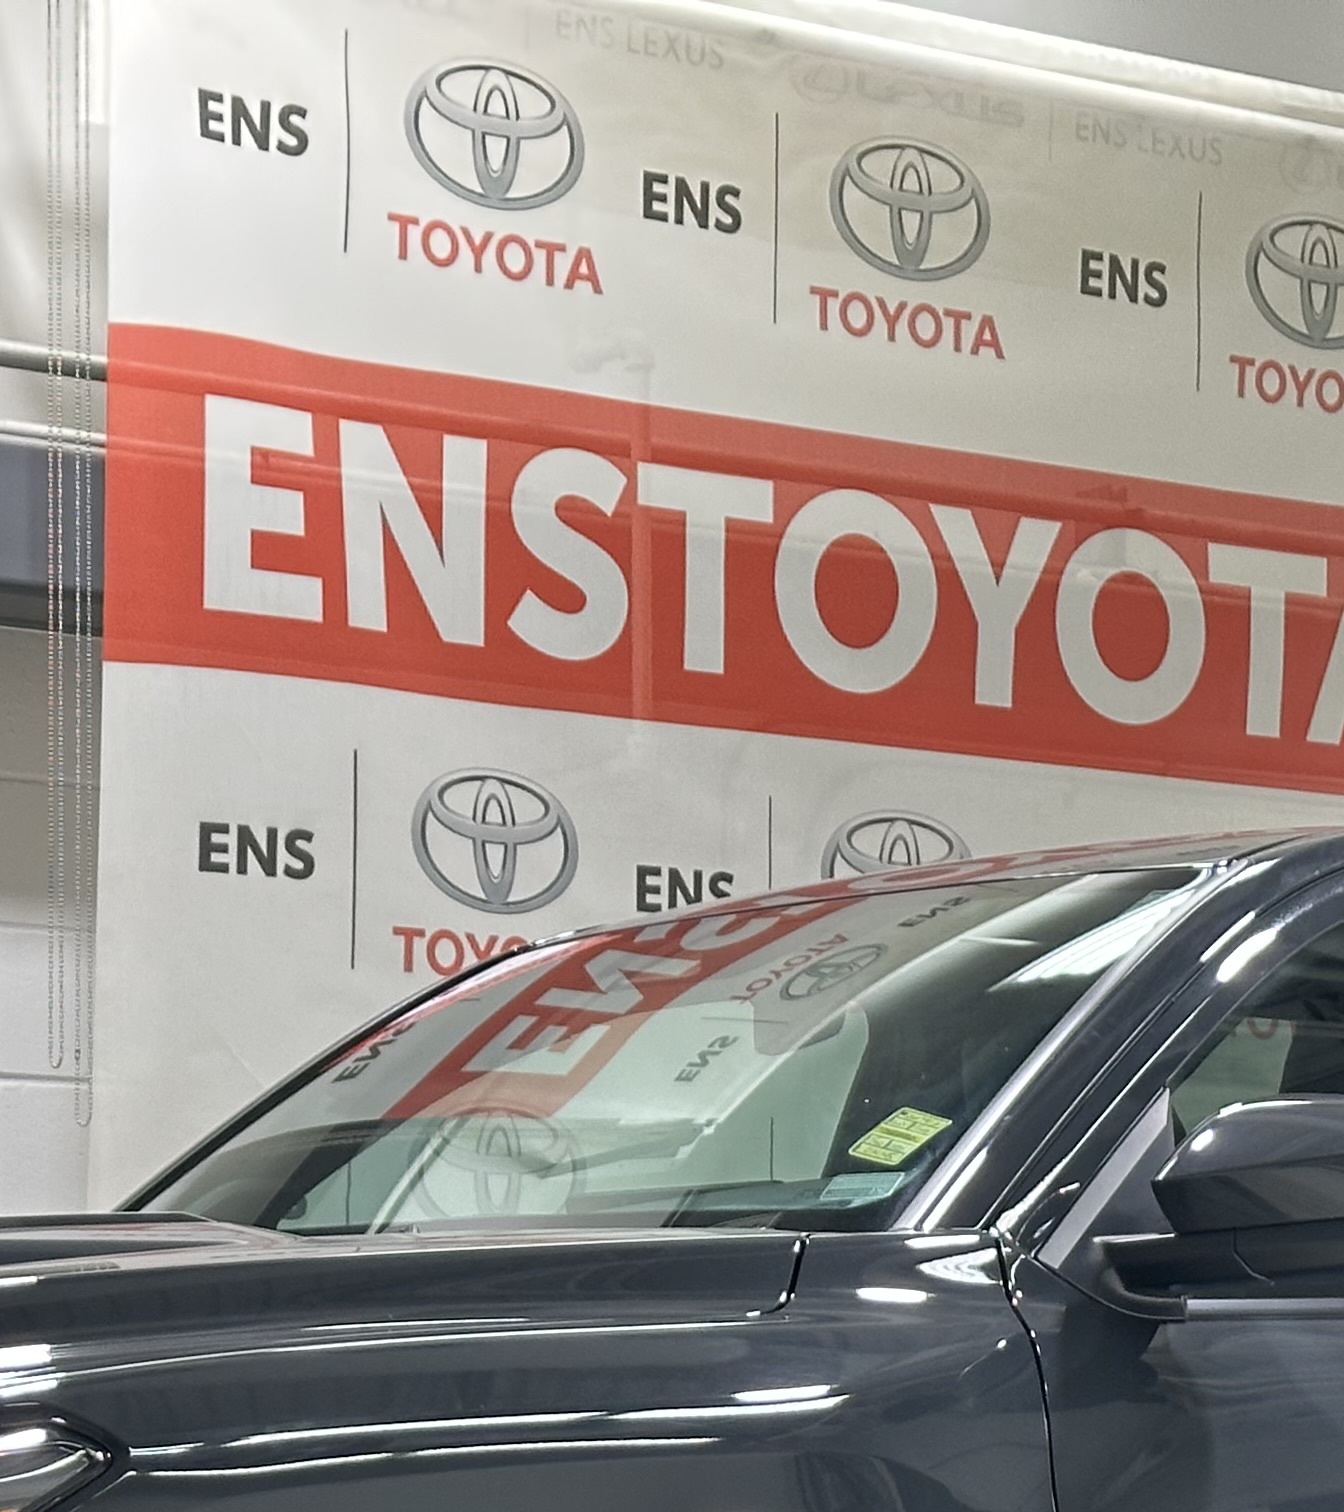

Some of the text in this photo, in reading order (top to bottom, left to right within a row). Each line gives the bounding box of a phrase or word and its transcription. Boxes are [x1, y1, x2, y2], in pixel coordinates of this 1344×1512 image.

[555, 12, 725, 71] ENS LEXUS
[197, 86, 309, 157] ENS
[1074, 112, 1223, 167] ENS LEXUS
[641, 169, 743, 235] ENS
[387, 212, 604, 295] TOYOTA
[1078, 247, 1168, 309] ENS
[809, 285, 1006, 361] TOYOTA
[197, 821, 316, 881] ENS
[636, 864, 735, 913] ENS
[392, 925, 530, 977] TOY
